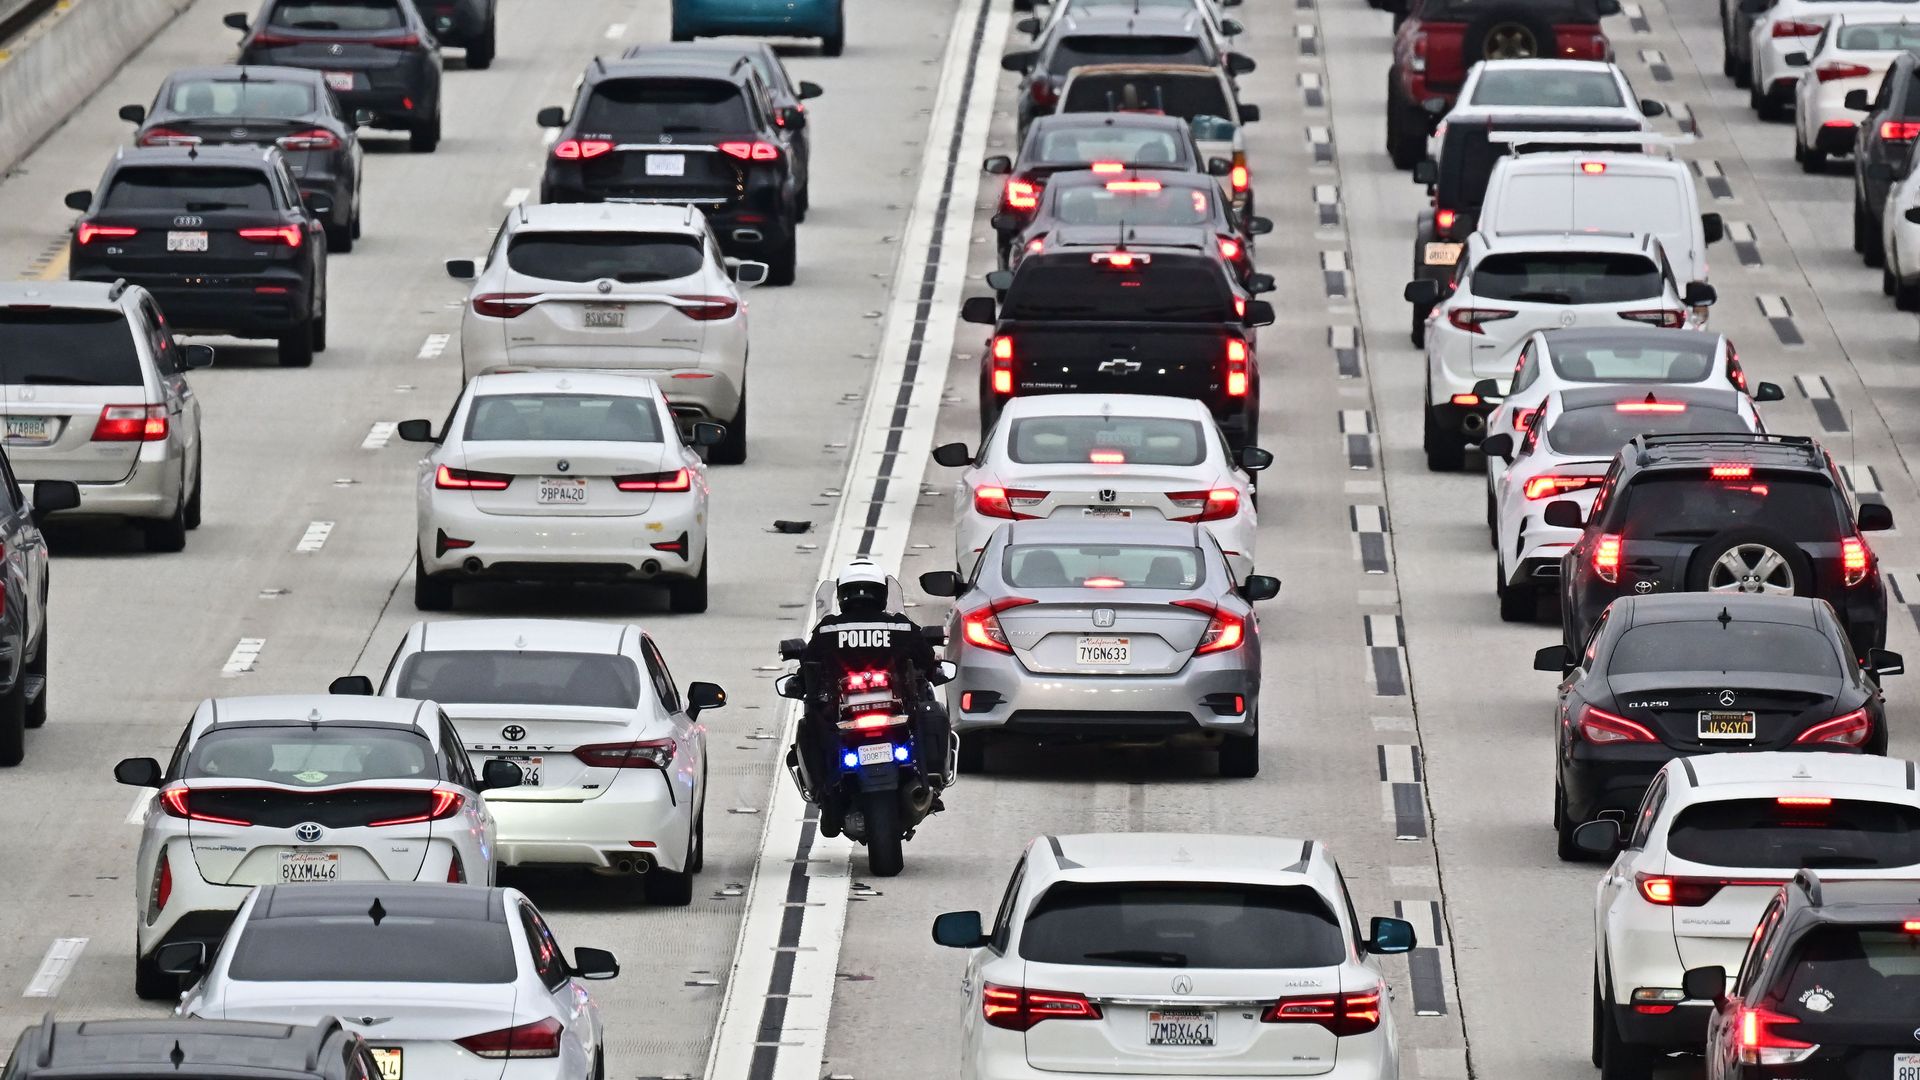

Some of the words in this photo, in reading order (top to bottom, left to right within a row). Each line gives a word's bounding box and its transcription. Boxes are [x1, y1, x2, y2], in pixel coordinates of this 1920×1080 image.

[541, 488, 584, 500] 9BPA420
[838, 630, 891, 648] POLICE
[1087, 638, 1119, 647] California
[1080, 647, 1127, 660] 7YGN633
[290, 853, 325, 863] California
[282, 864, 336, 878] 8XXM446
[1798, 988, 1816, 1003] Baby
[1152, 1023, 1210, 1039] 7MBX461
